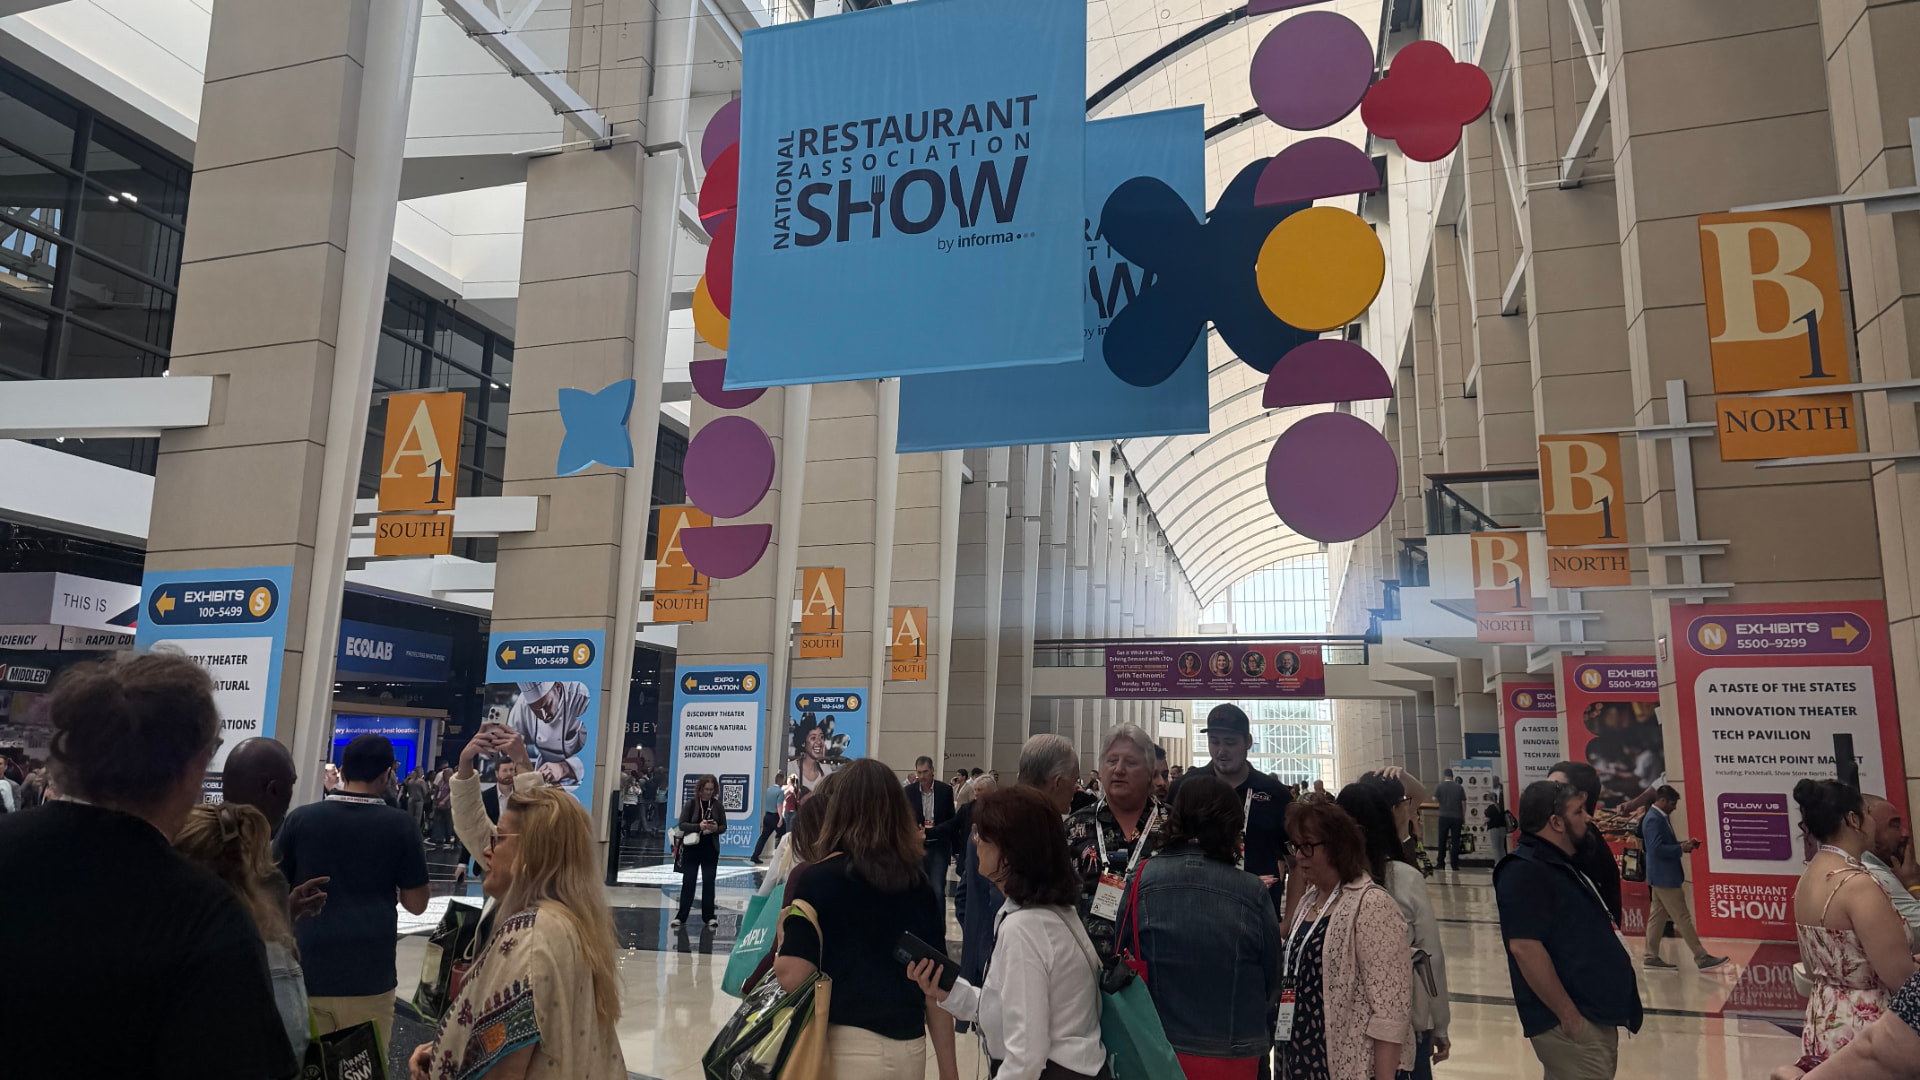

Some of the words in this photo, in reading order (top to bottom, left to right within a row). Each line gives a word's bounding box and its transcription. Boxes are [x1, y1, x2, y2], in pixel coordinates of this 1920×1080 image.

[798, 94, 1038, 158] RESTAURANT
[797, 131, 1031, 180] ASSOCIATION
[773, 130, 795, 250] NATIONAL
[795, 155, 1029, 247] SHOW
[937, 237, 954, 253] by
[957, 231, 1014, 248] informa
[1724, 406, 1850, 434] NORTH
[379, 522, 446, 539] SOUTH
[1552, 555, 1627, 572] NORTH
[184, 589, 245, 603] EXHIBITS
[254, 592, 265, 612] S
[63, 593, 91, 610] THIS
[95, 599, 107, 613] IS
[656, 598, 704, 610] SOUTH
[199, 606, 243, 618] 100-5499
[1479, 619, 1532, 632] NORTH
[1735, 622, 1820, 635] EXHIBITS
[85, 634, 115, 646] RAPID
[1703, 628, 1722, 646] N
[345, 636, 394, 660] ECOLAB
[802, 639, 840, 649] SOUTH
[1737, 638, 1807, 649] 5500-9299
[522, 645, 570, 655] EXHIBITS
[577, 648, 586, 661] S
[207, 655, 248, 665] THEATER
[534, 656, 569, 665] 100-5499
[893, 664, 924, 673] SOUTH
[1607, 669, 1657, 678] EXHIBIT
[9, 667, 51, 683] MIDDLEBY
[1585, 673, 1597, 685] N
[214, 680, 250, 691] ATURAL
[1708, 683, 1718, 693] A
[1720, 683, 1758, 693] TASTE
[1762, 683, 1779, 692] OF
[1782, 683, 1806, 692] THE
[1809, 682, 1857, 692] STATES
[1520, 696, 1530, 705] N
[1710, 706, 1796, 716] INNOVATION
[1799, 706, 1858, 716] THEATER
[220, 719, 257, 730] ATIONS
[1712, 729, 1744, 740] TECH
[1747, 730, 1811, 741] PAVILION
[1714, 755, 1735, 764] THE
[1737, 755, 1777, 764] MATCH
[1780, 755, 1815, 764] POINT
[721, 834, 751, 845] SHOW
[1716, 884, 1788, 896] RESTAURANT
[1709, 884, 1718, 918] NATIONAL
[1717, 900, 1787, 920] SHOW
